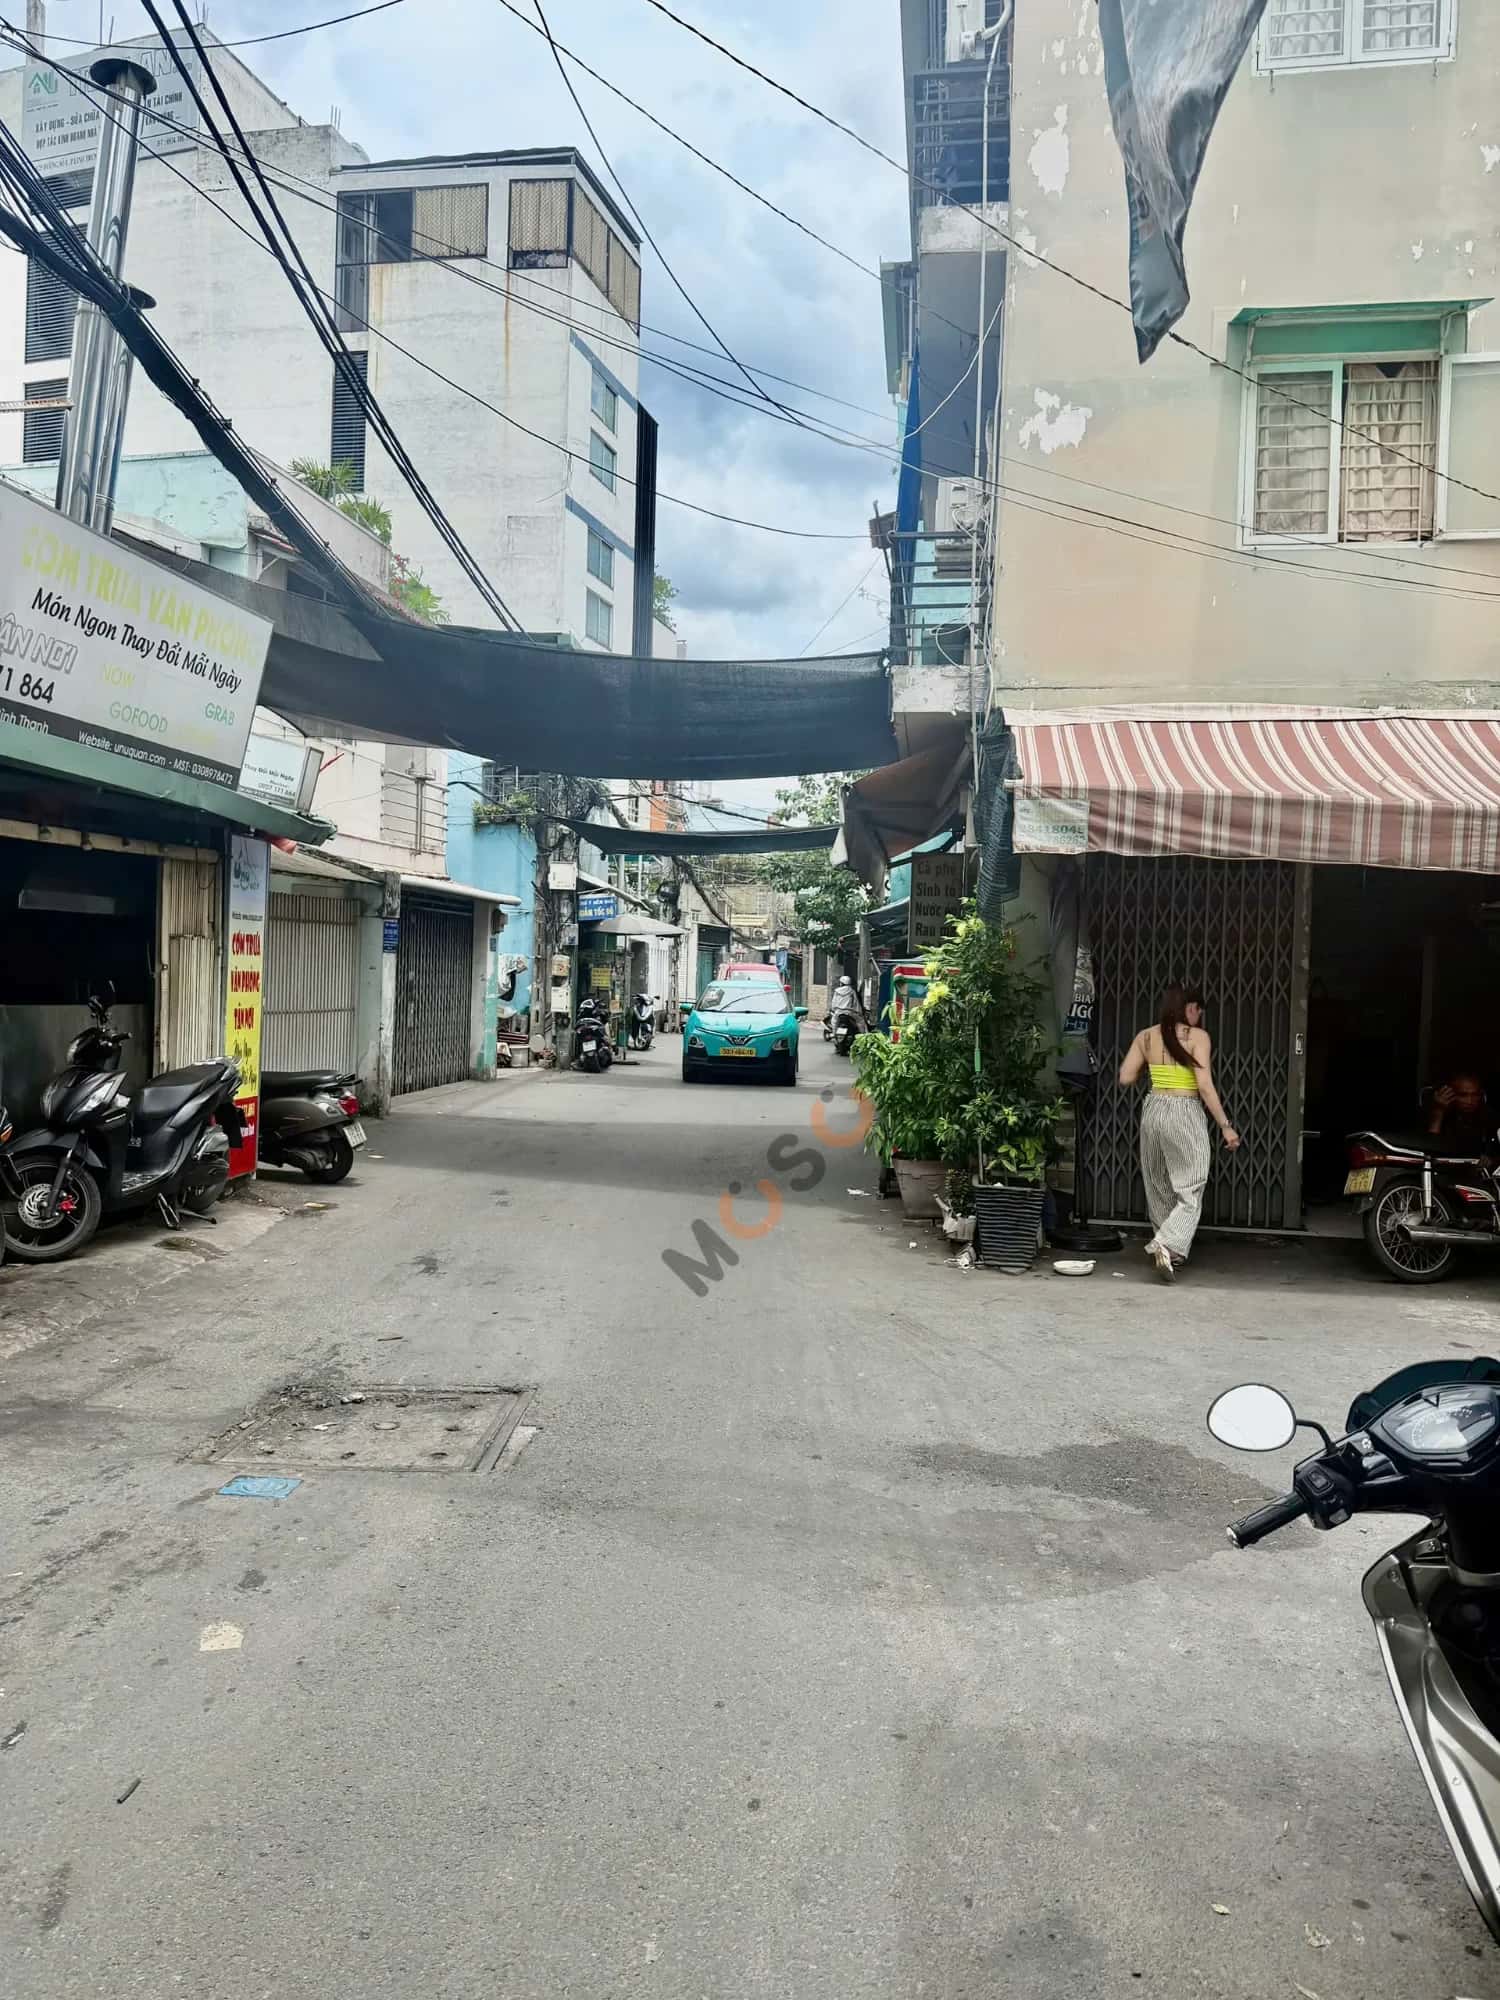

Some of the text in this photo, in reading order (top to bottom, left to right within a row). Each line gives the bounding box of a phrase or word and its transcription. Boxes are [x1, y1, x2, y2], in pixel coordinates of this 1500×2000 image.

[31, 586, 242, 694] Món Ngon Thay Đổi Mỗi Ngày
[19, 672, 55, 704] 864
[109, 701, 169, 734] GOFOOD
[204, 701, 236, 727] GRAB
[78, 730, 113, 752] Website:
[113, 742, 167, 766] unuquan.com
[173, 757, 192, 775] MST:
[915, 881, 941, 897] Sinh
[914, 900, 941, 917] Nước
[914, 921, 937, 937] Rau
[1074, 992, 1091, 1004] BIA
